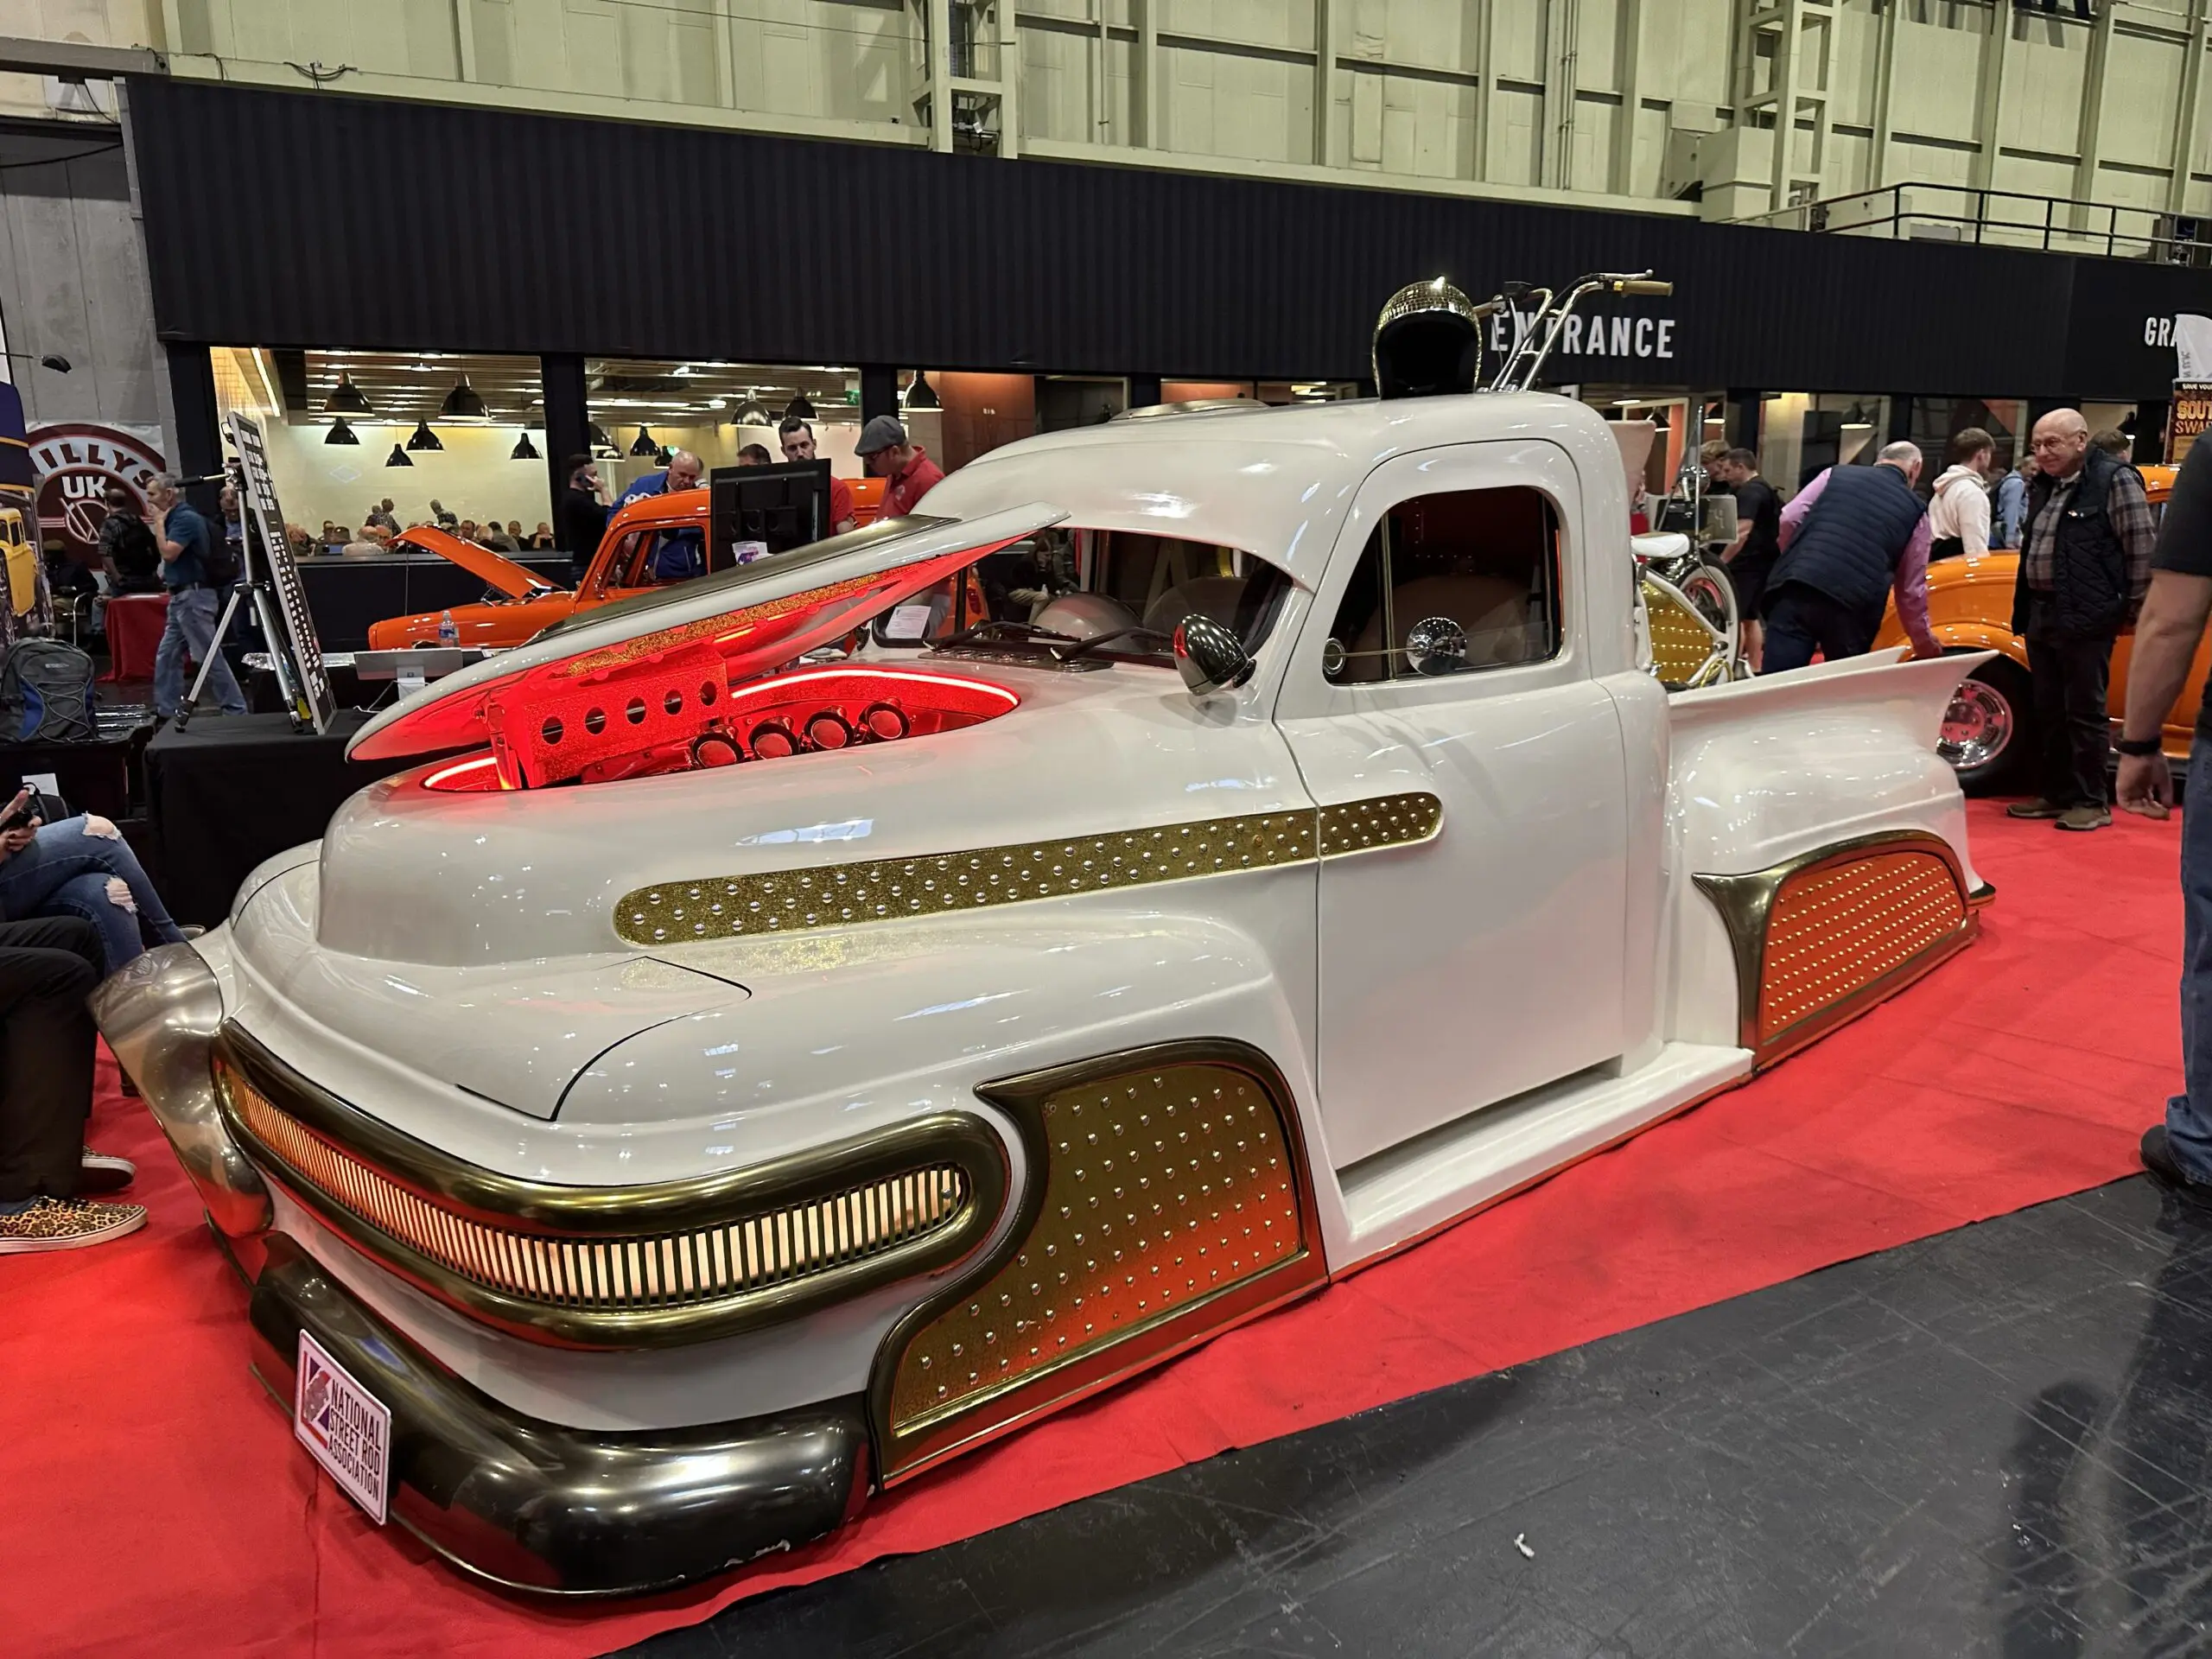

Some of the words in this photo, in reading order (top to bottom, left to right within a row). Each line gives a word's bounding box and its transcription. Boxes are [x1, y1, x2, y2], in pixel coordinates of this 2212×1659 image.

[1491, 311, 1675, 359] ENTRANCE
[30, 443, 154, 490] ILLYS
[61, 476, 106, 499] UK
[329, 1408, 360, 1456] STREET
[361, 1439, 380, 1476] ROD
[331, 1379, 381, 1452] NATIONAL
[328, 1433, 379, 1501] ASSOCIATION
